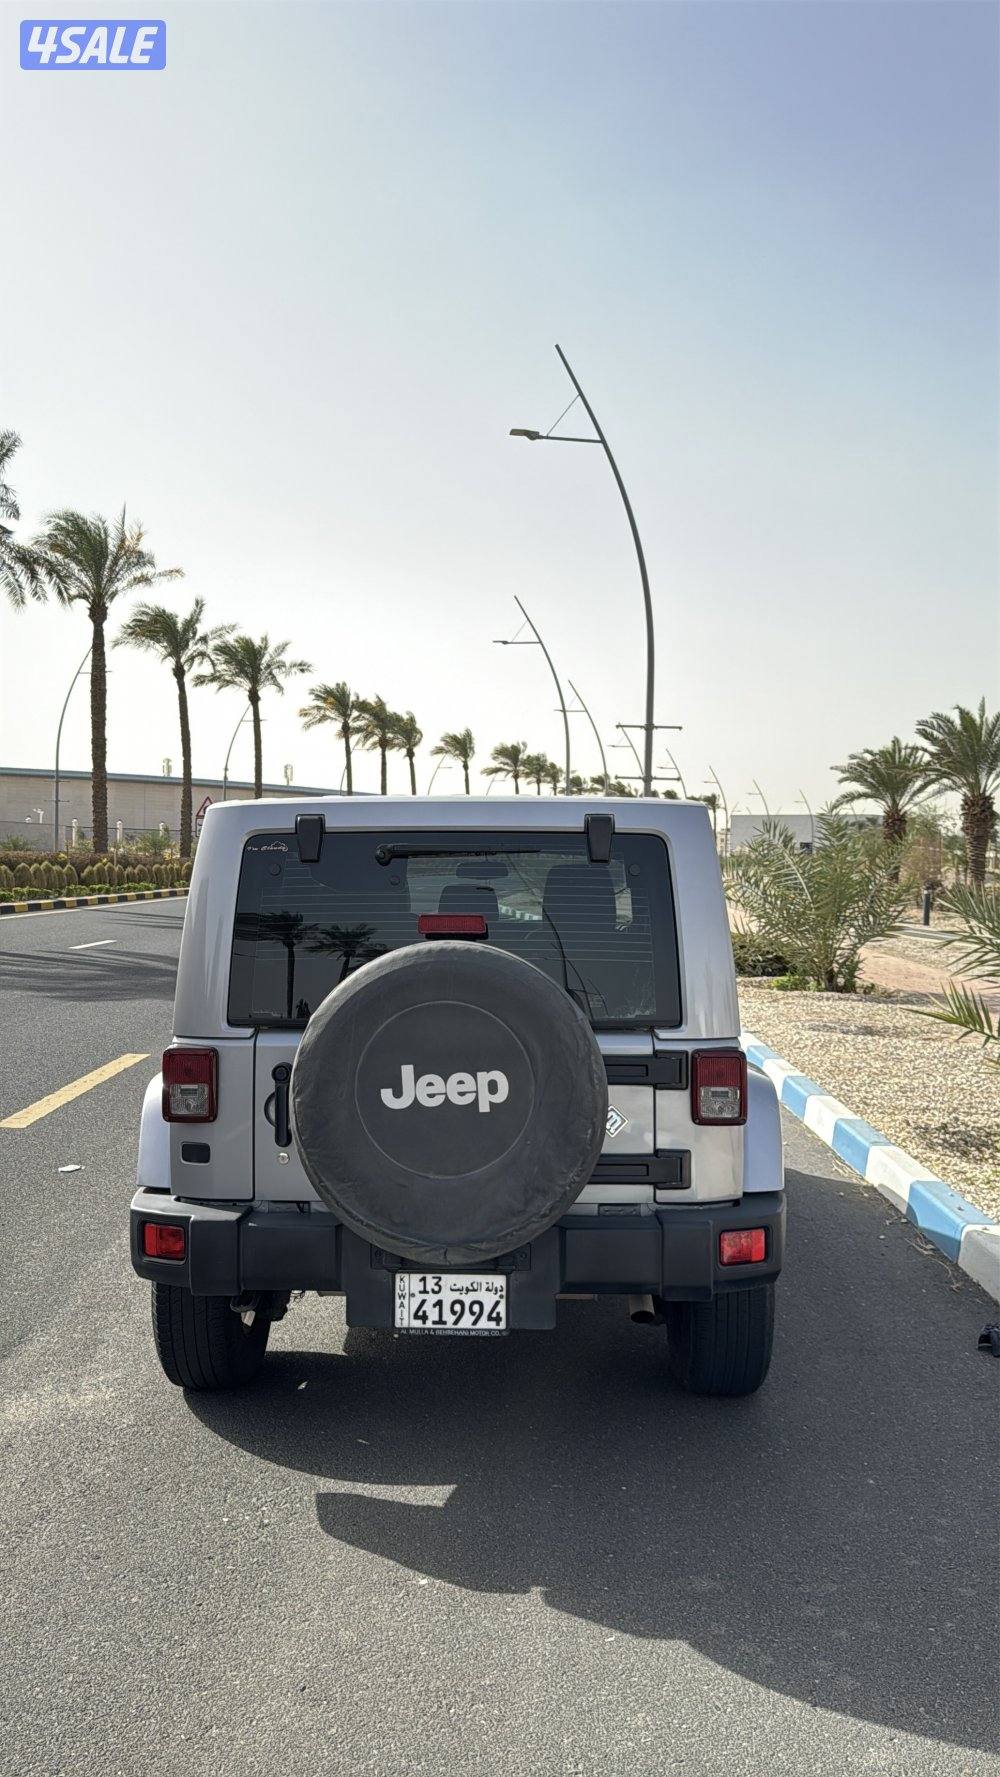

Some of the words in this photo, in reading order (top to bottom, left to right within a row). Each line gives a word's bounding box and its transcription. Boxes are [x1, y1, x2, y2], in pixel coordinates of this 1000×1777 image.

[380, 1064, 509, 1113] Jeep
[418, 1276, 442, 1295] 13
[450, 1281, 482, 1295] الكويت
[485, 1281, 504, 1296] دولة
[397, 1275, 407, 1327] KUWAIT
[413, 1299, 503, 1327] 41994
